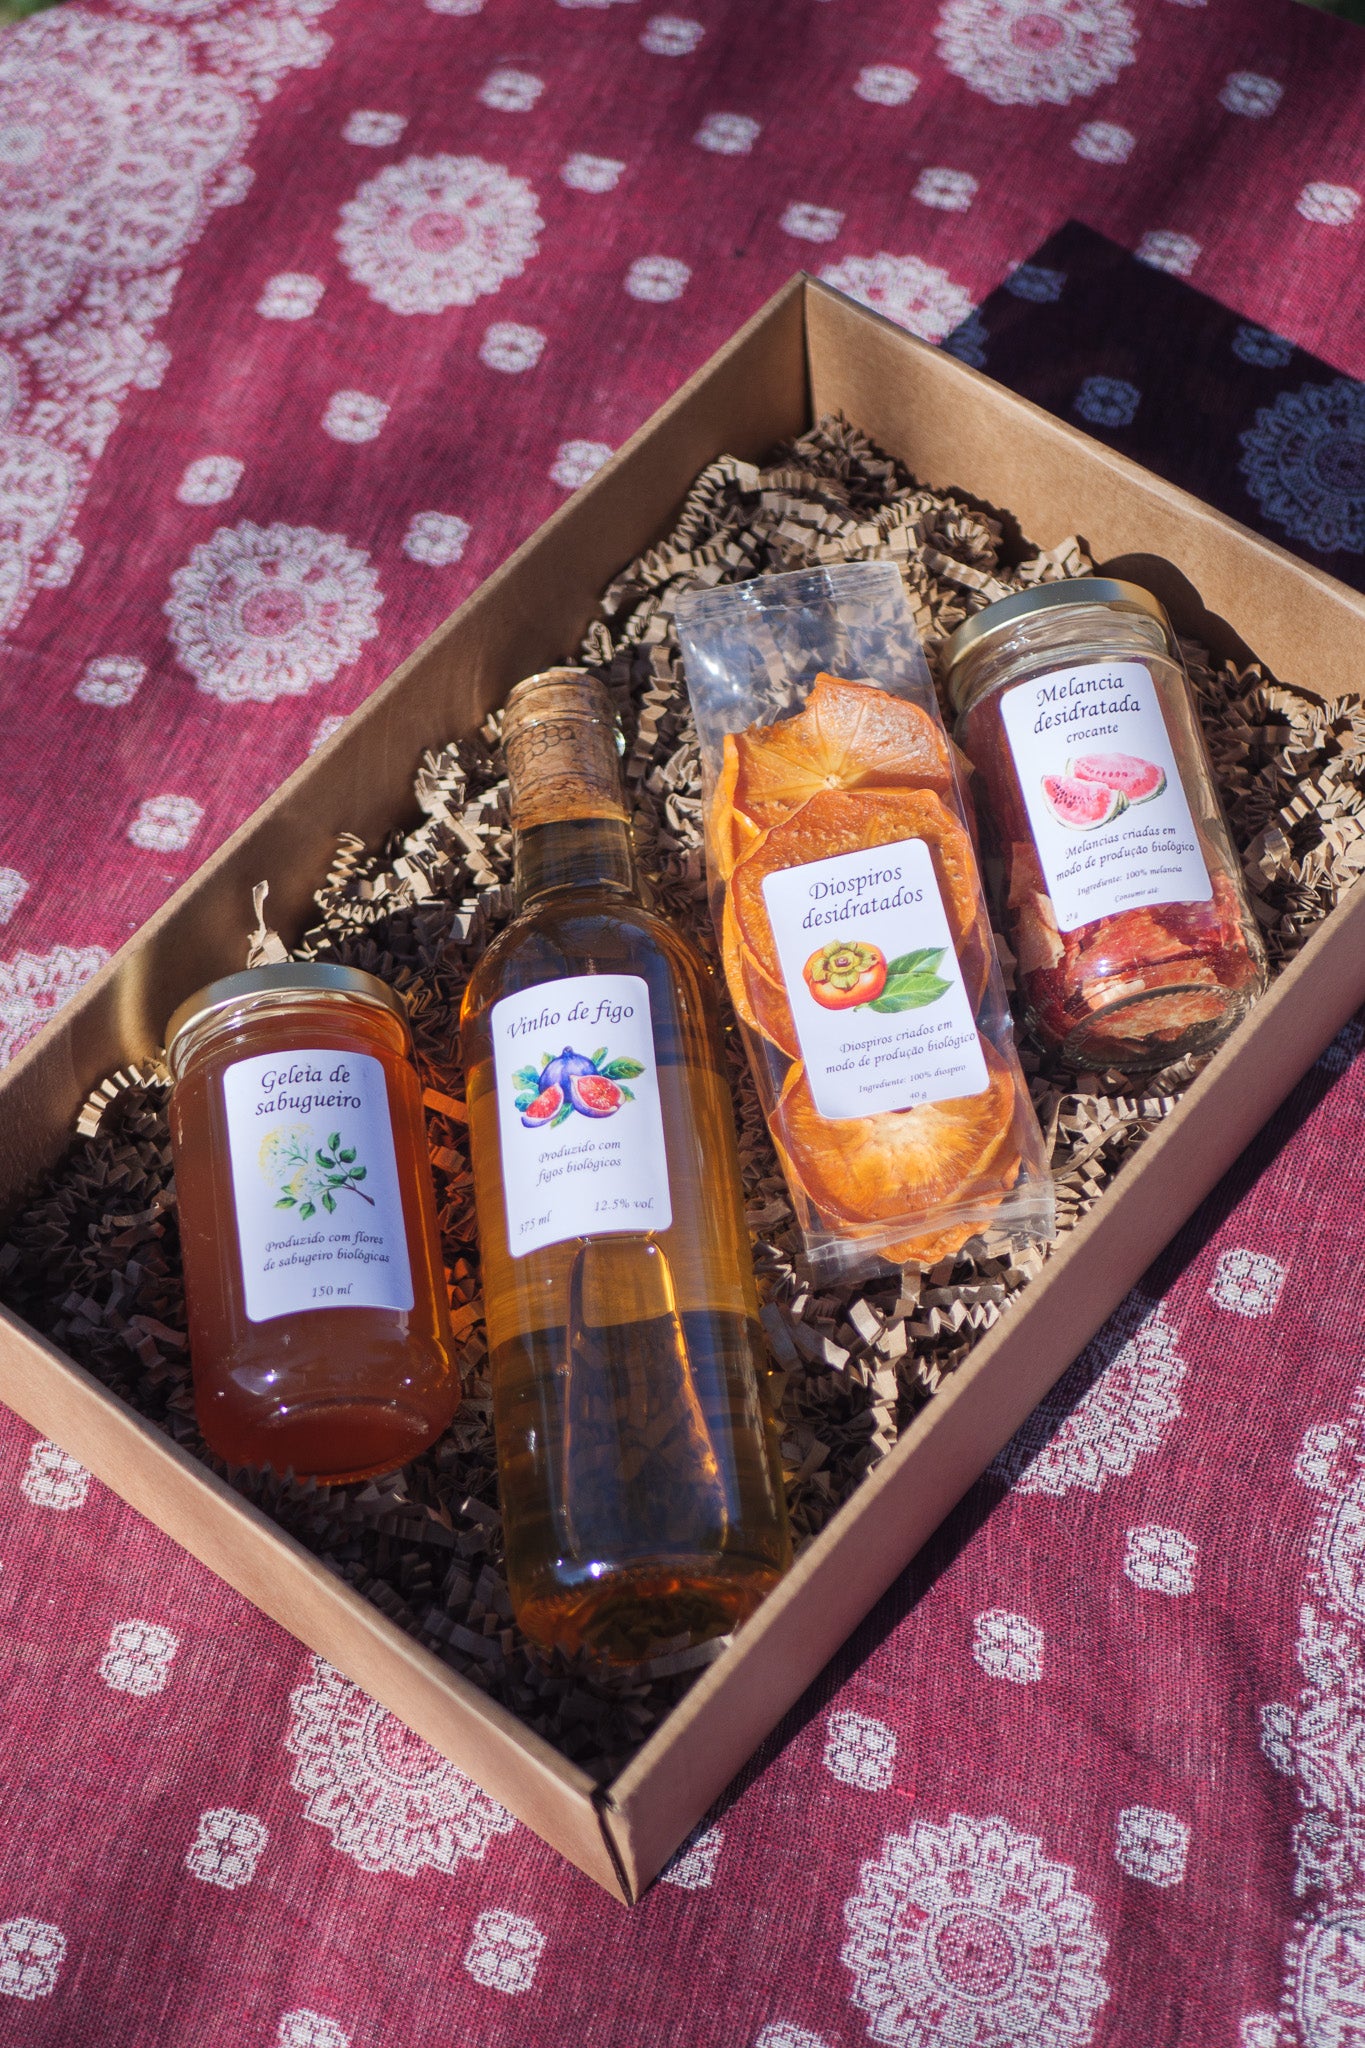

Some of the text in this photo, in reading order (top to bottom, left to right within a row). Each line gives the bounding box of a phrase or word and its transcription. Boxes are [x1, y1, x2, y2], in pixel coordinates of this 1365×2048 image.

[1036, 673, 1124, 707] Melancia
[1034, 694, 1141, 734] desidratada
[1066, 724, 1119, 743] crocante
[1065, 825, 1176, 859] Melancias criadas em
[1056, 840, 1195, 881] modo de produção biológico
[808, 867, 902, 900] Diospiros
[1077, 864, 1183, 896] Ingrediente: 100% melancia
[802, 886, 924, 929] desidratados
[507, 999, 634, 1039] Vinho de figo
[840, 1020, 953, 1053] Diospiros criados em
[825, 1032, 975, 1074] modo de produção biológico
[261, 1065, 350, 1094] Geleia de
[858, 1064, 966, 1093] Ingrediente: 100% diospiro
[255, 1091, 361, 1116] sabugueiro
[538, 1140, 621, 1163] Produzido com
[536, 1157, 621, 1187] figos biológicos
[594, 1198, 630, 1211] 12.5%
[519, 1210, 552, 1235] 375 ml
[265, 1231, 384, 1252] Produzido com flores
[263, 1248, 390, 1271] de sabugeiro biológicas
[312, 1283, 353, 1297] 150 ml
